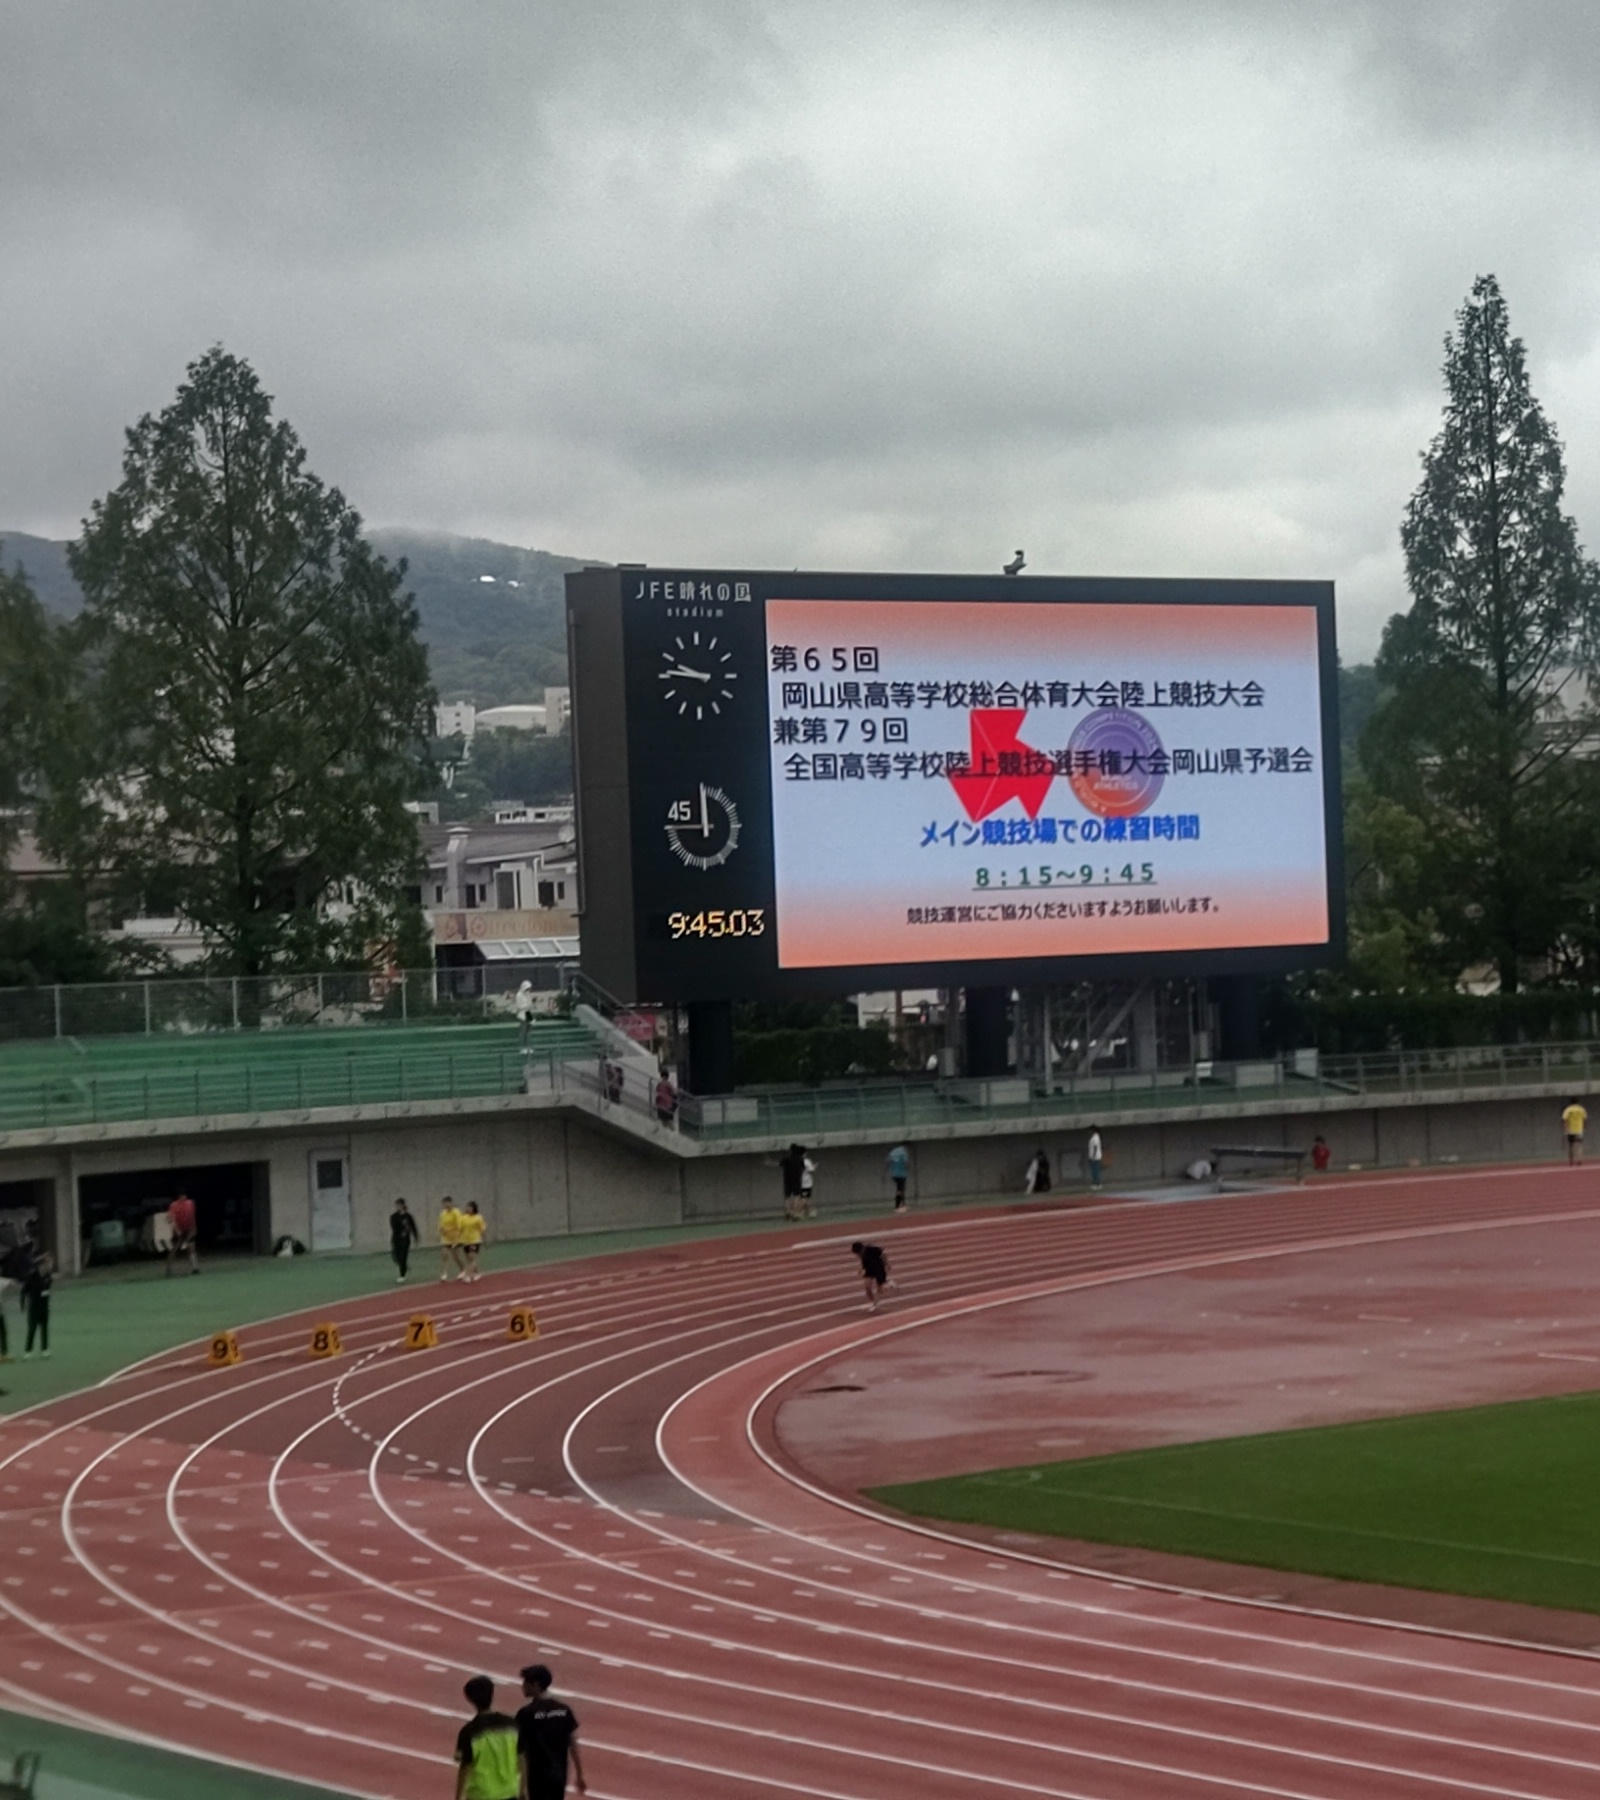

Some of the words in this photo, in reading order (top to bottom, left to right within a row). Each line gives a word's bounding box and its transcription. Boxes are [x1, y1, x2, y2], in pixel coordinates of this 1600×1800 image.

[667, 606, 724, 618] stadium
[770, 645, 879, 673] 第65回
[781, 679, 1266, 710] 岡山県高等学校総合体育大会陸上競技大会
[773, 716, 909, 744] 兼第79回
[783, 747, 1314, 782] 全国高等学校陸上競技選手権大会岡山県予選会
[667, 801, 691, 821] 45
[919, 815, 1200, 848] メイン競技場での練習時間
[906, 896, 1220, 925] 競技運営にご協力くださいますようお願いします。
[410, 1322, 425, 1342] 7
[511, 1315, 525, 1333] 6
[212, 1339, 228, 1359] 9
[314, 1330, 329, 1352] 8
